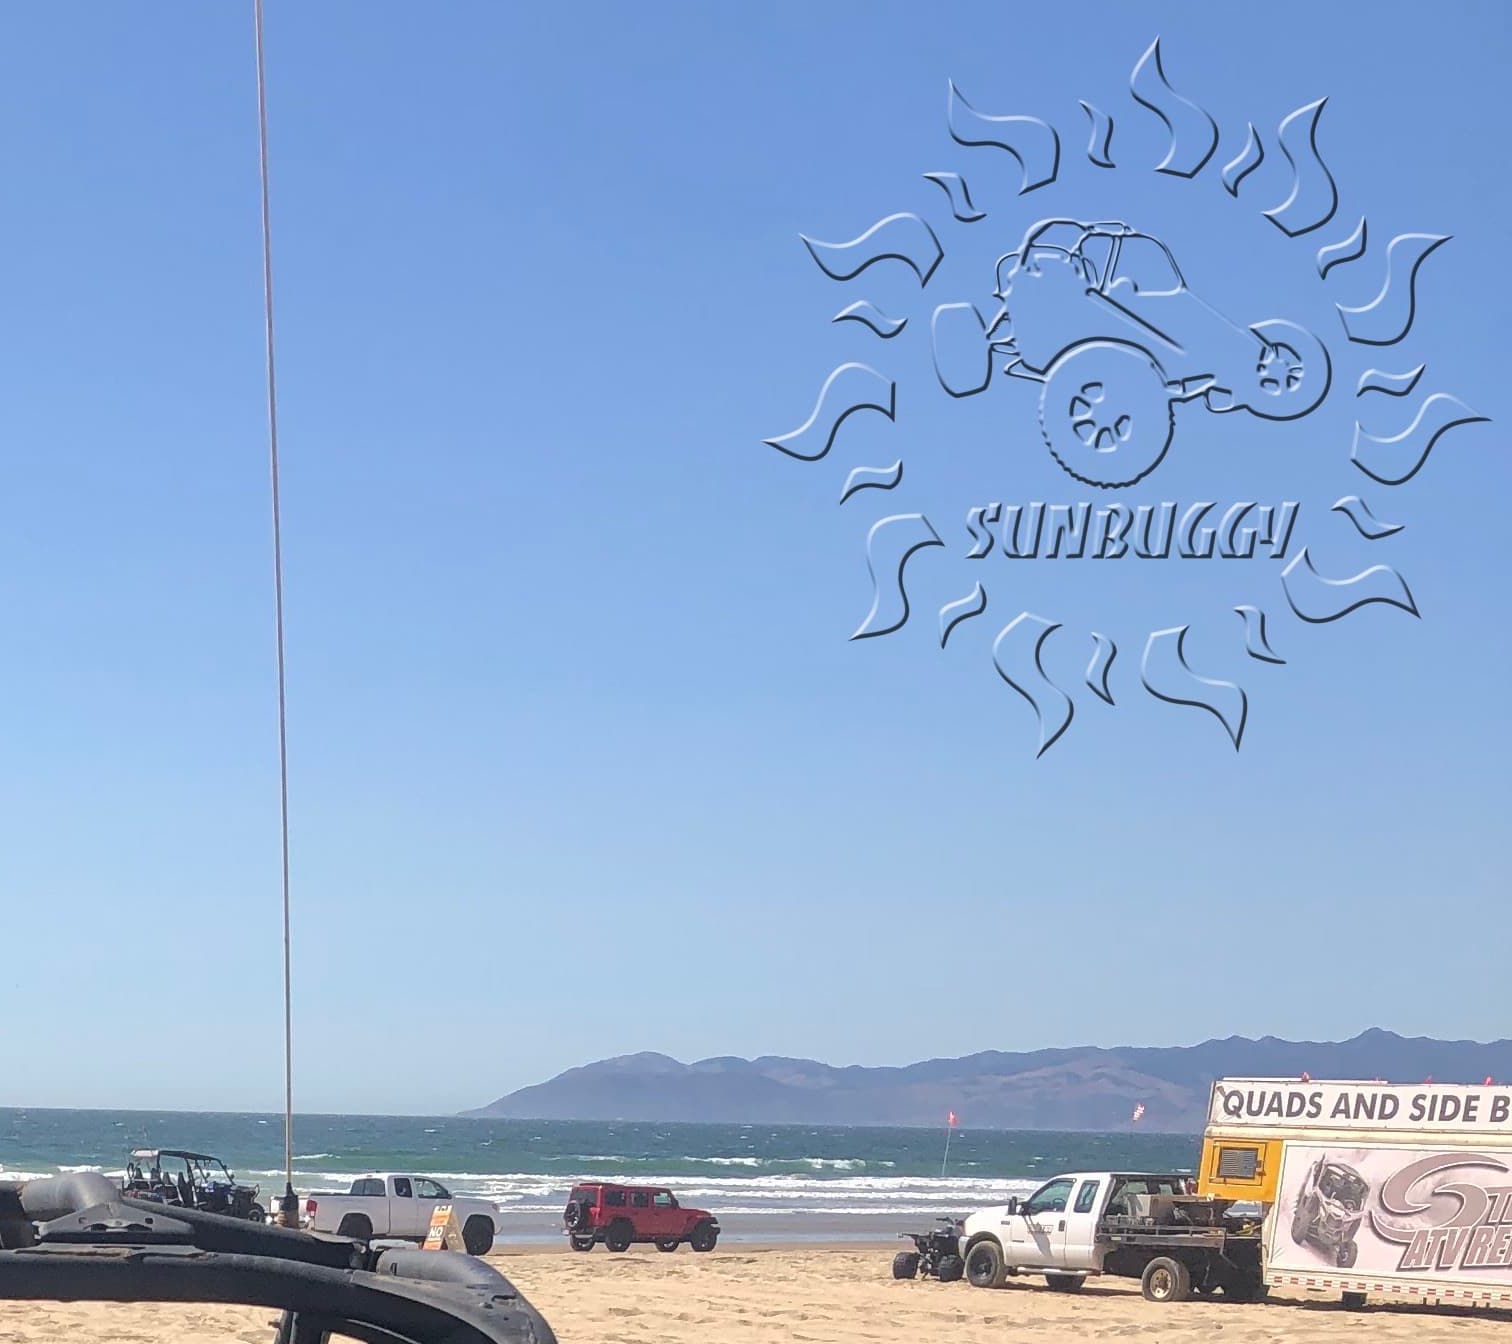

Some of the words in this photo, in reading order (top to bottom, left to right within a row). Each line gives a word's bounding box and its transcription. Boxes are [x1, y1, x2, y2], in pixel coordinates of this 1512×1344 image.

[1222, 1089, 1324, 1120] QUADS
[1330, 1092, 1400, 1121] AND
[1408, 1094, 1481, 1123] SIDE
[1397, 1227, 1471, 1270] ATV
